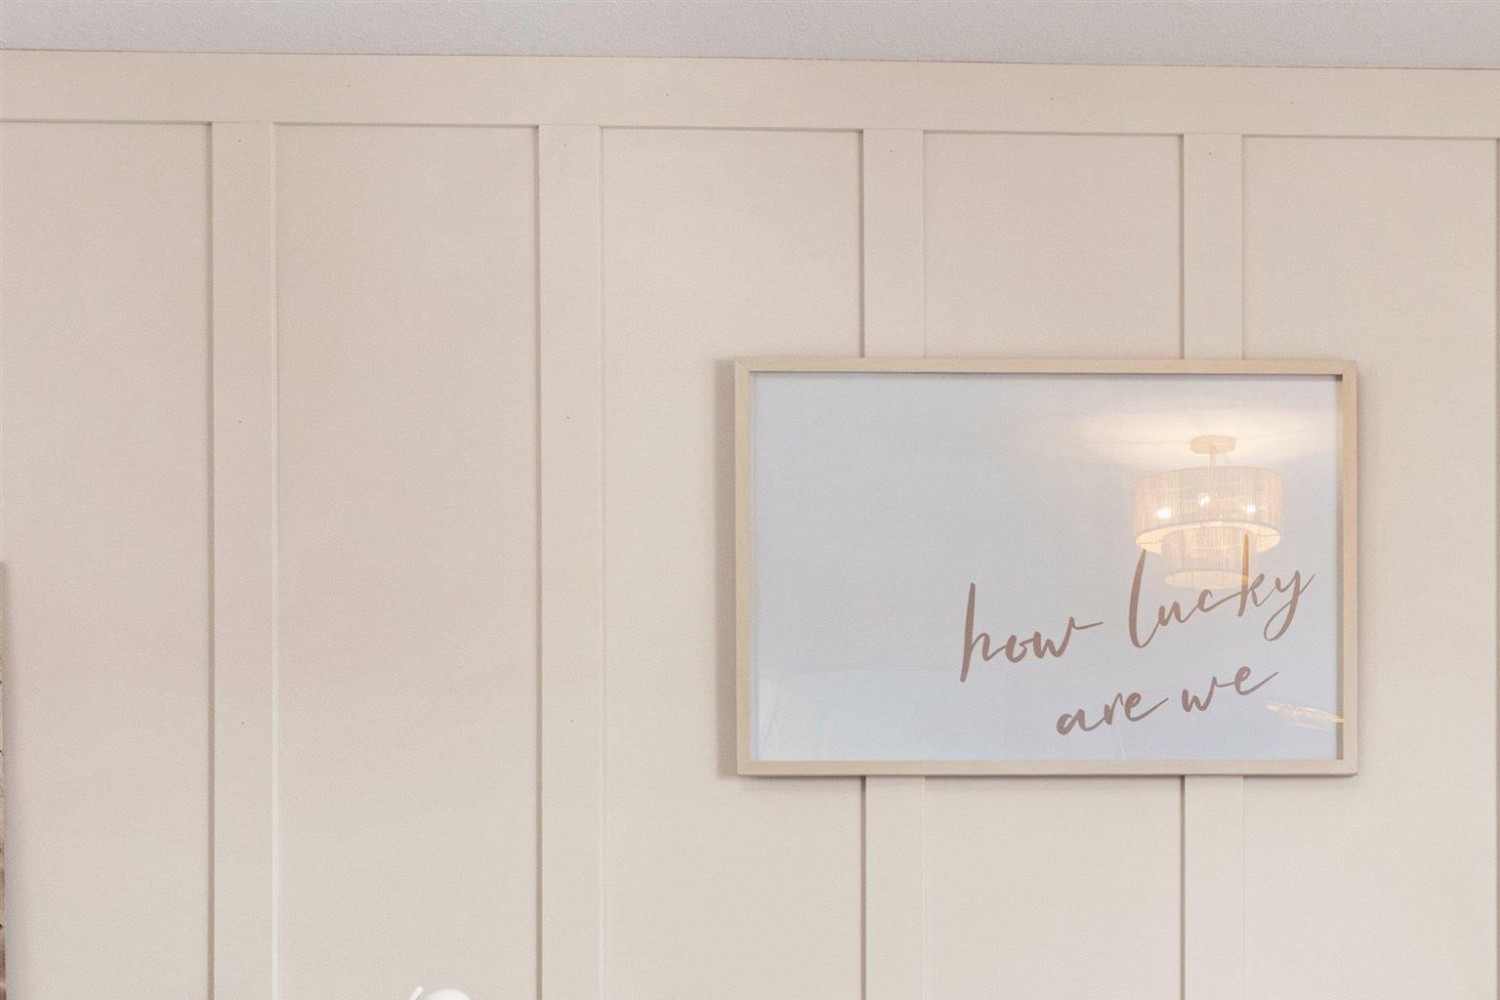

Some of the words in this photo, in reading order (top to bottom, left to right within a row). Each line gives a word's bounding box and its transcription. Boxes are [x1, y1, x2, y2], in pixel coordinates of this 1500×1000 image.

[960, 582, 1104, 683] how
[1128, 534, 1316, 649] lucky
[1055, 690, 1170, 737] are
[1181, 665, 1280, 714] we
